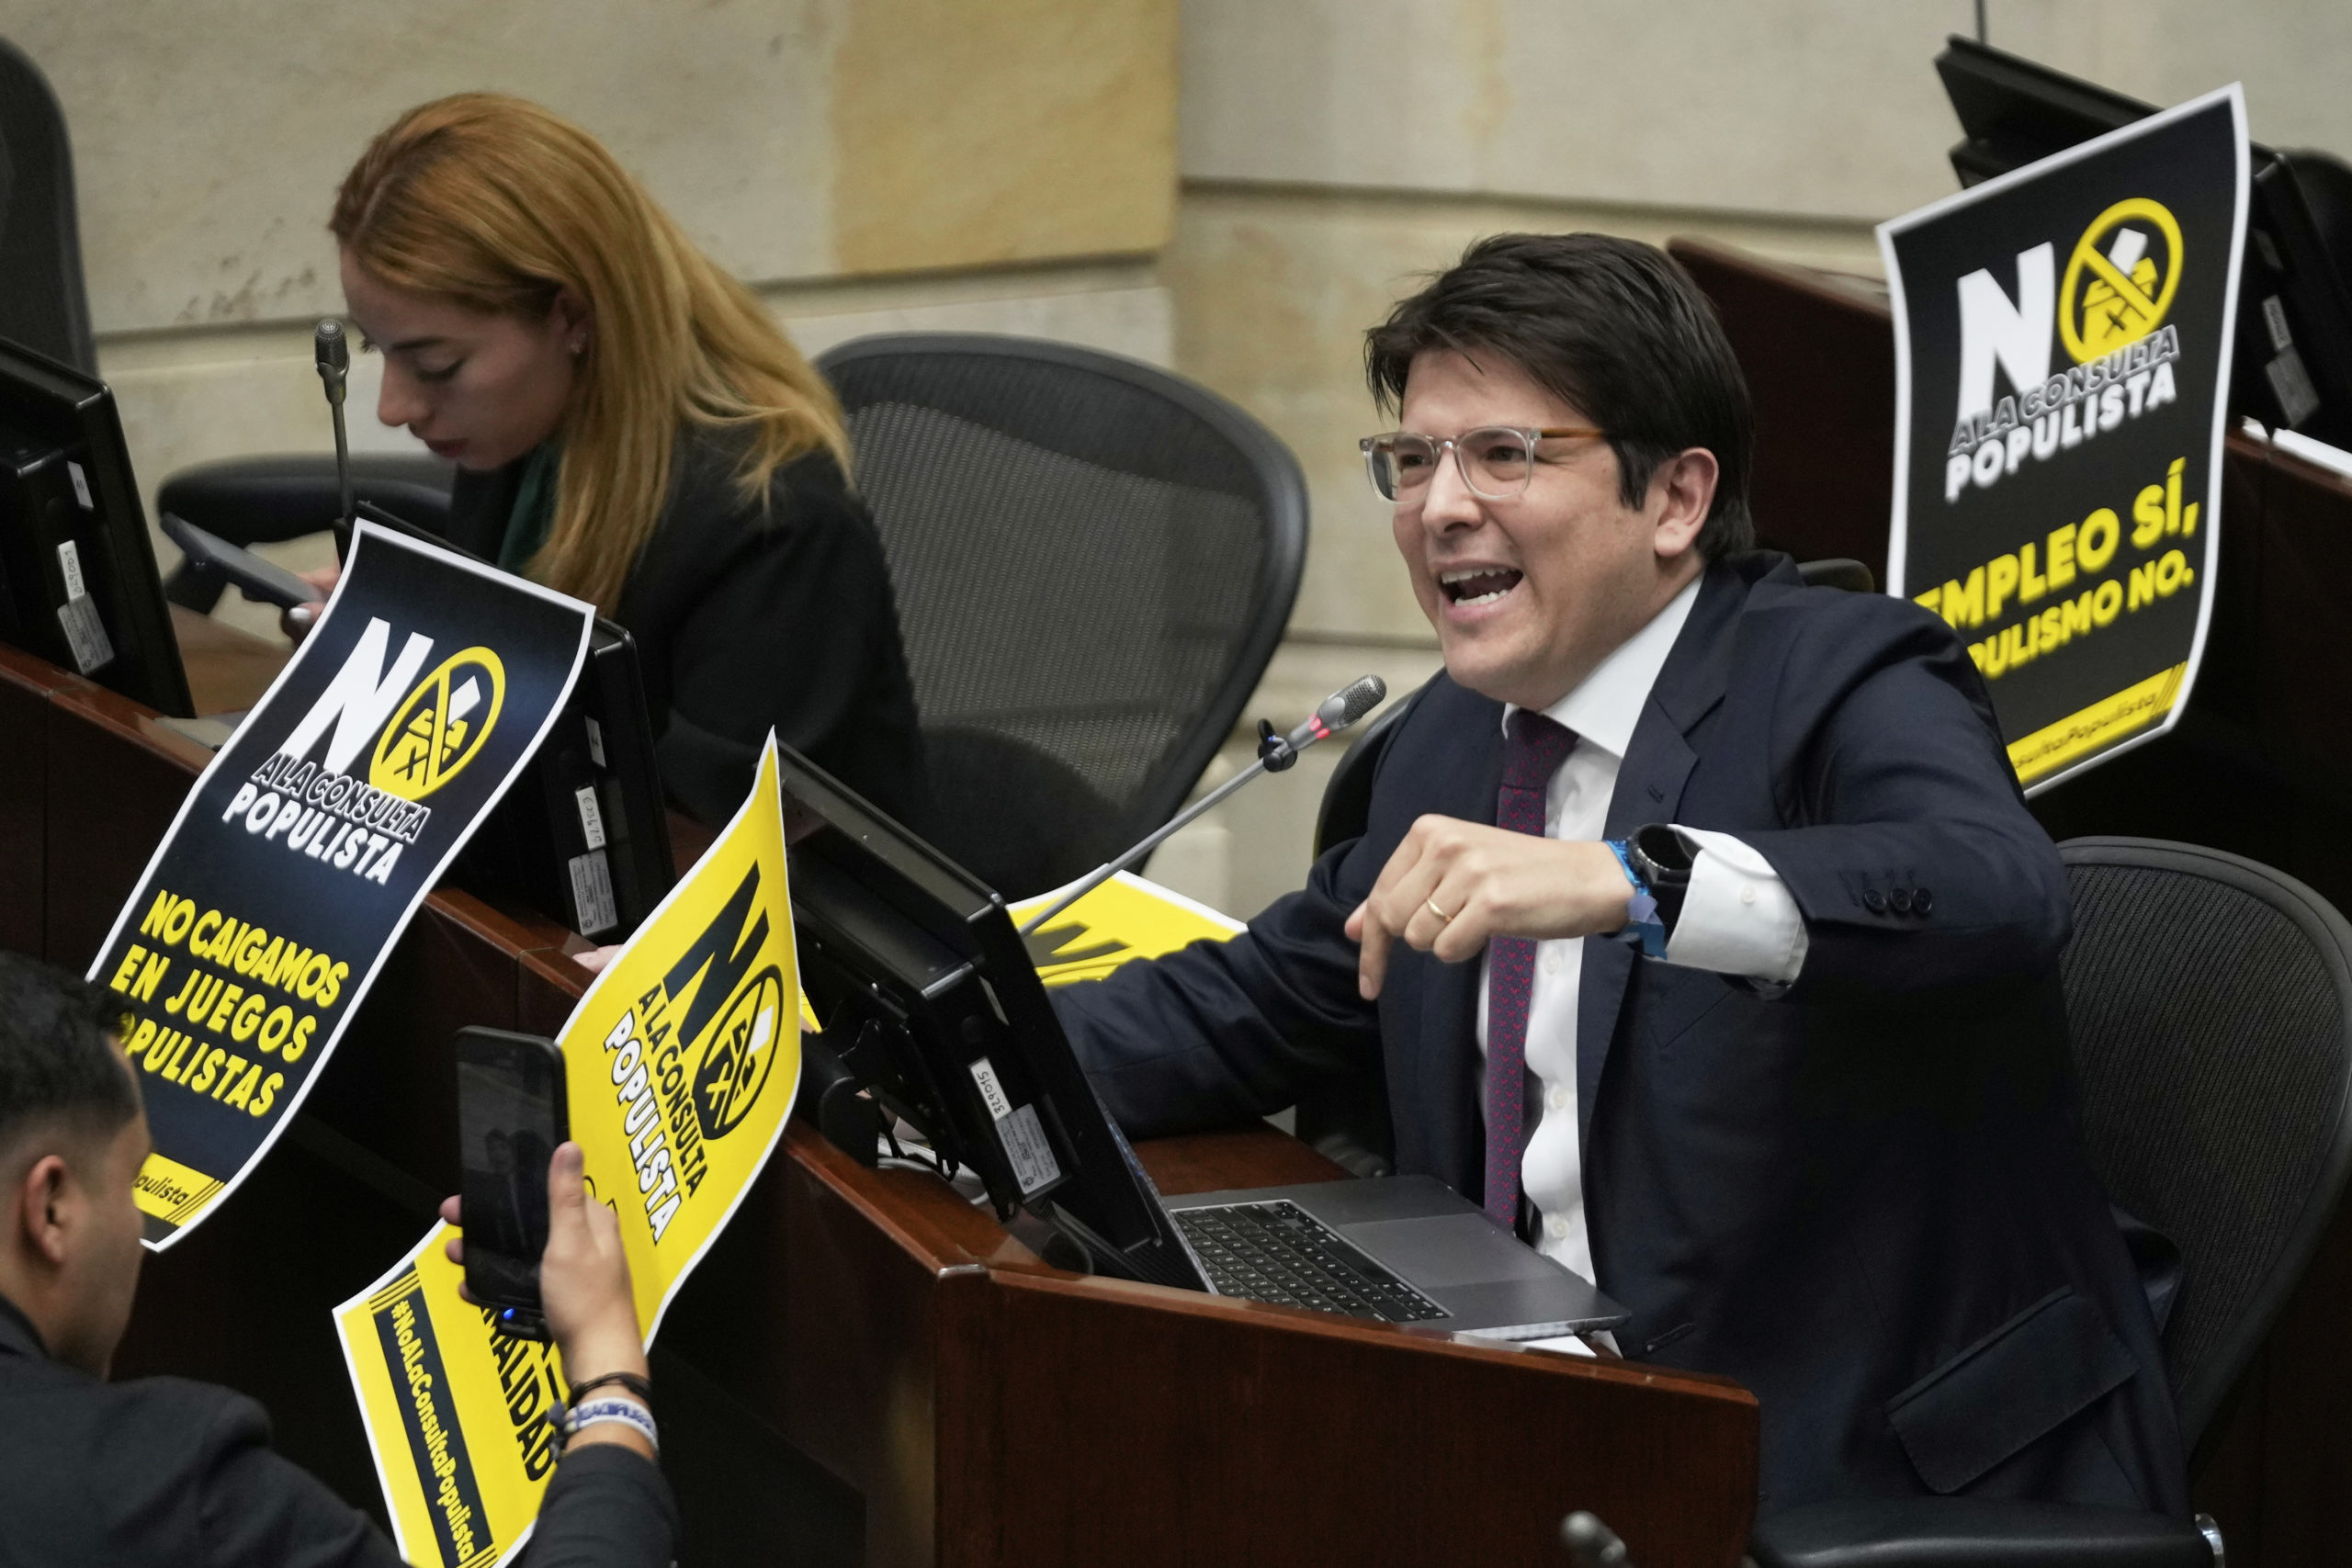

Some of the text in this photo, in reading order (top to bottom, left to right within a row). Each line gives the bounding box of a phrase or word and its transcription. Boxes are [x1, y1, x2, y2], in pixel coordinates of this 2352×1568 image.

[2018, 324, 2180, 421] CONSULTA
[1945, 361, 2177, 503] POPULISTA
[2131, 456, 2199, 549] SÍ,
[2127, 549, 2194, 613] NO.
[222, 782, 403, 886] POPULISTA
[306, 772, 431, 845] CONSULTA
[110, 943, 317, 1064] EN JUEGOS
[140, 889, 349, 1008] NO CAIGAMOS
[604, 1007, 682, 1246] POPULISTA
[639, 982, 708, 1198] A LA CONSULTA
[977, 1071, 1005, 1114] 329015
[391, 1299, 475, 1563] #NoALaConsultaPopulista
